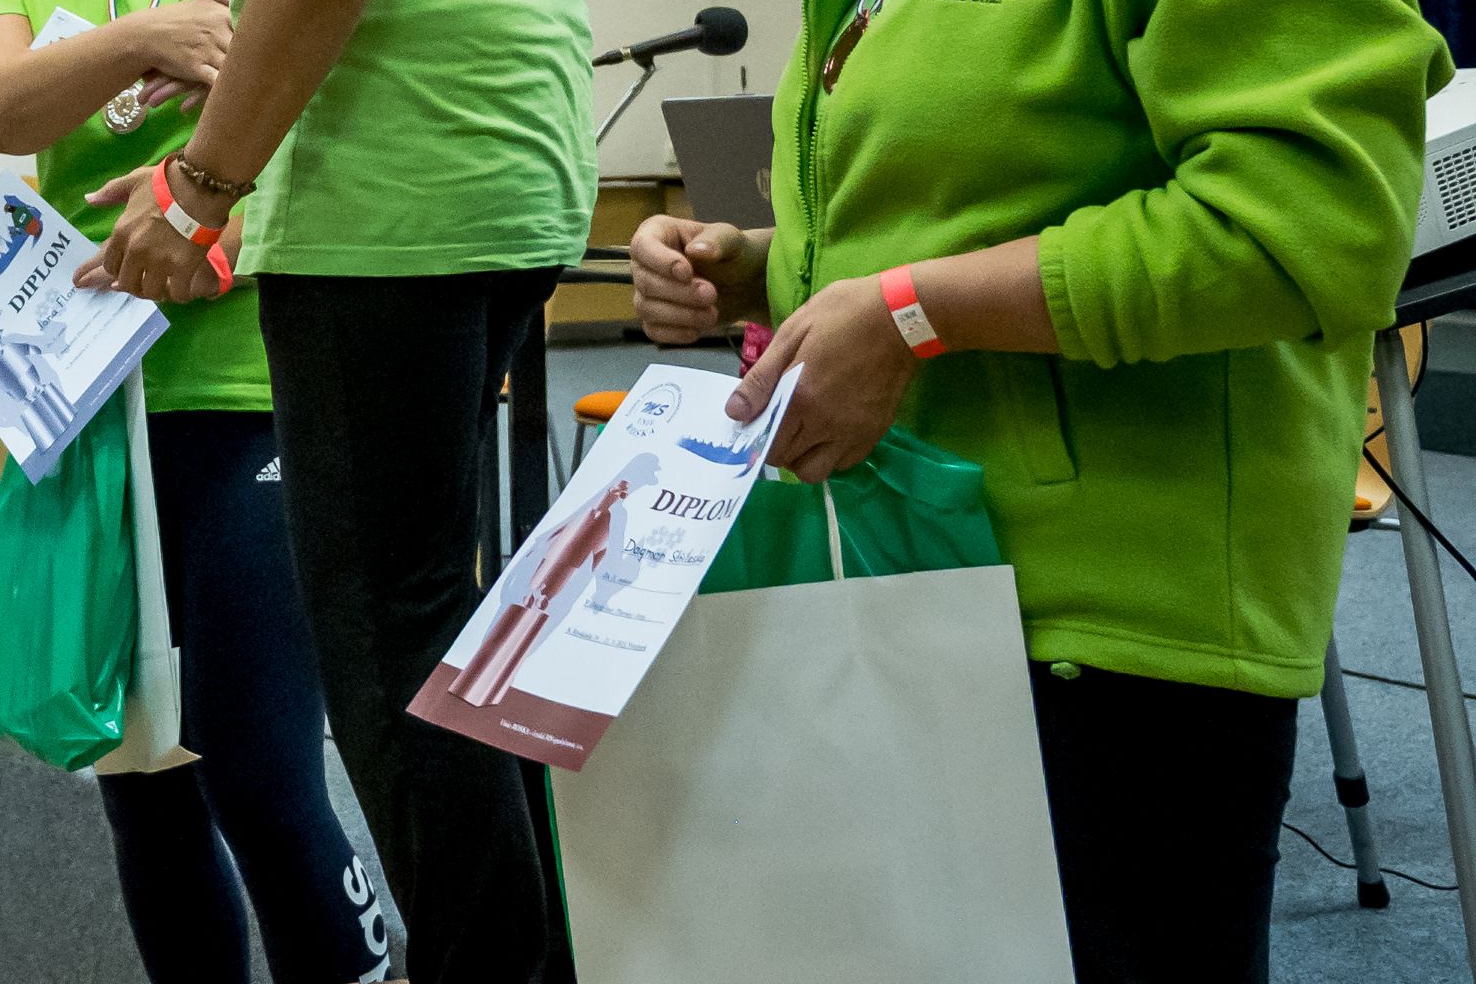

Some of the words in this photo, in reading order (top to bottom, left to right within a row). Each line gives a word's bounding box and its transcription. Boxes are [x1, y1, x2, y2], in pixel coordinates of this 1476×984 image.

[8, 230, 72, 314] DIPLOM
[256, 472, 282, 481] adid
[650, 488, 742, 521] DIPLOM
